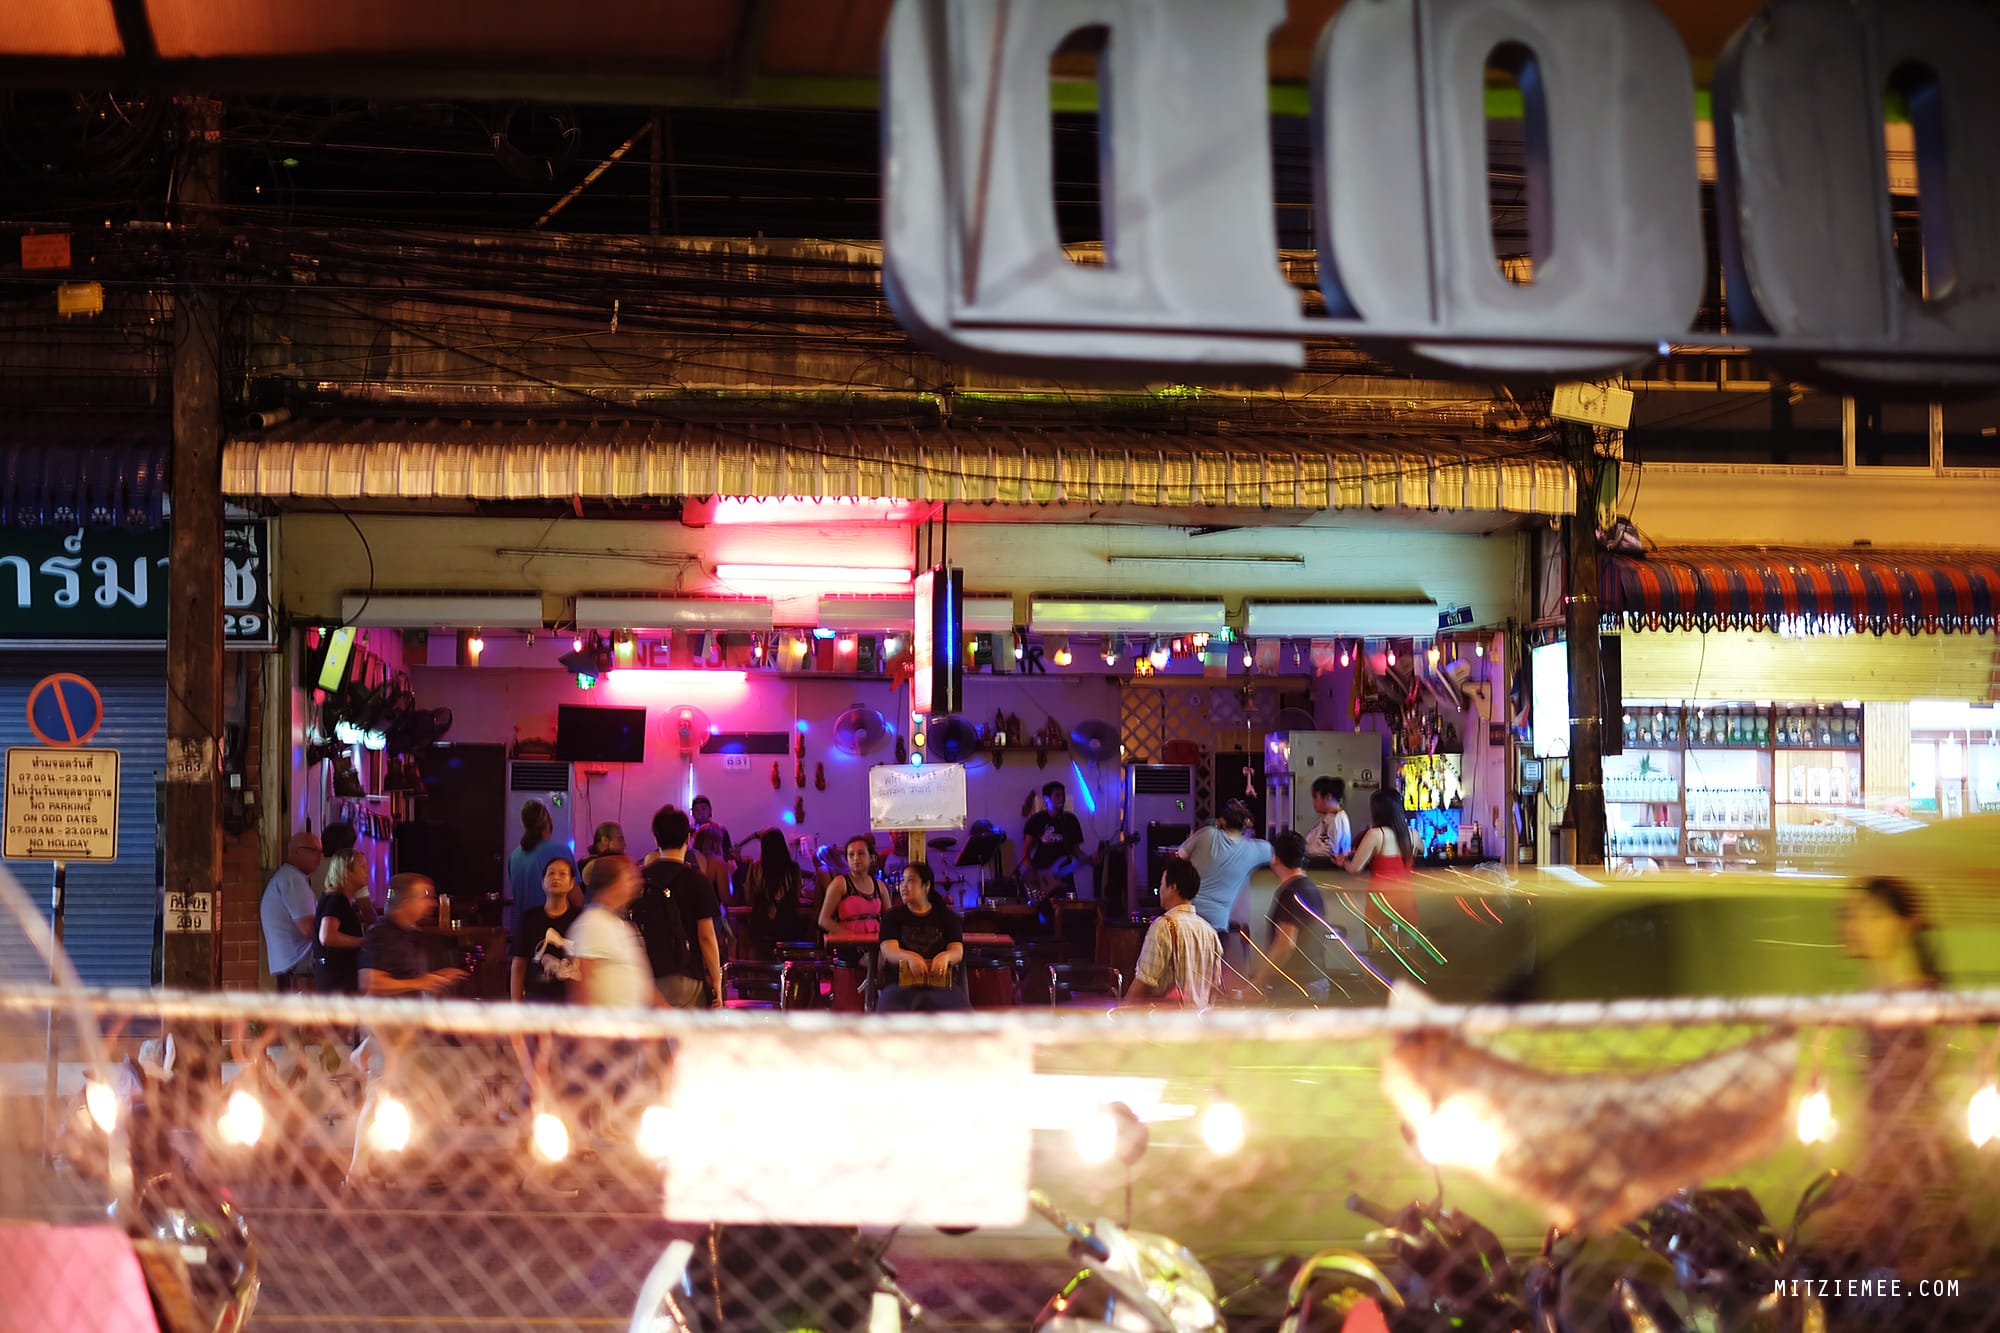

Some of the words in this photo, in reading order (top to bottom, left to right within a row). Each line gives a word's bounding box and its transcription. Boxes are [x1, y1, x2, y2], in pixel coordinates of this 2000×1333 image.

[31, 802, 45, 811] NO
[49, 802, 91, 811] PARKING
[23, 814, 37, 822] ON
[41, 814, 62, 823] ODD
[66, 815, 98, 823] DATES
[29, 839, 44, 847] NO
[47, 839, 89, 848] HOLIDAY
